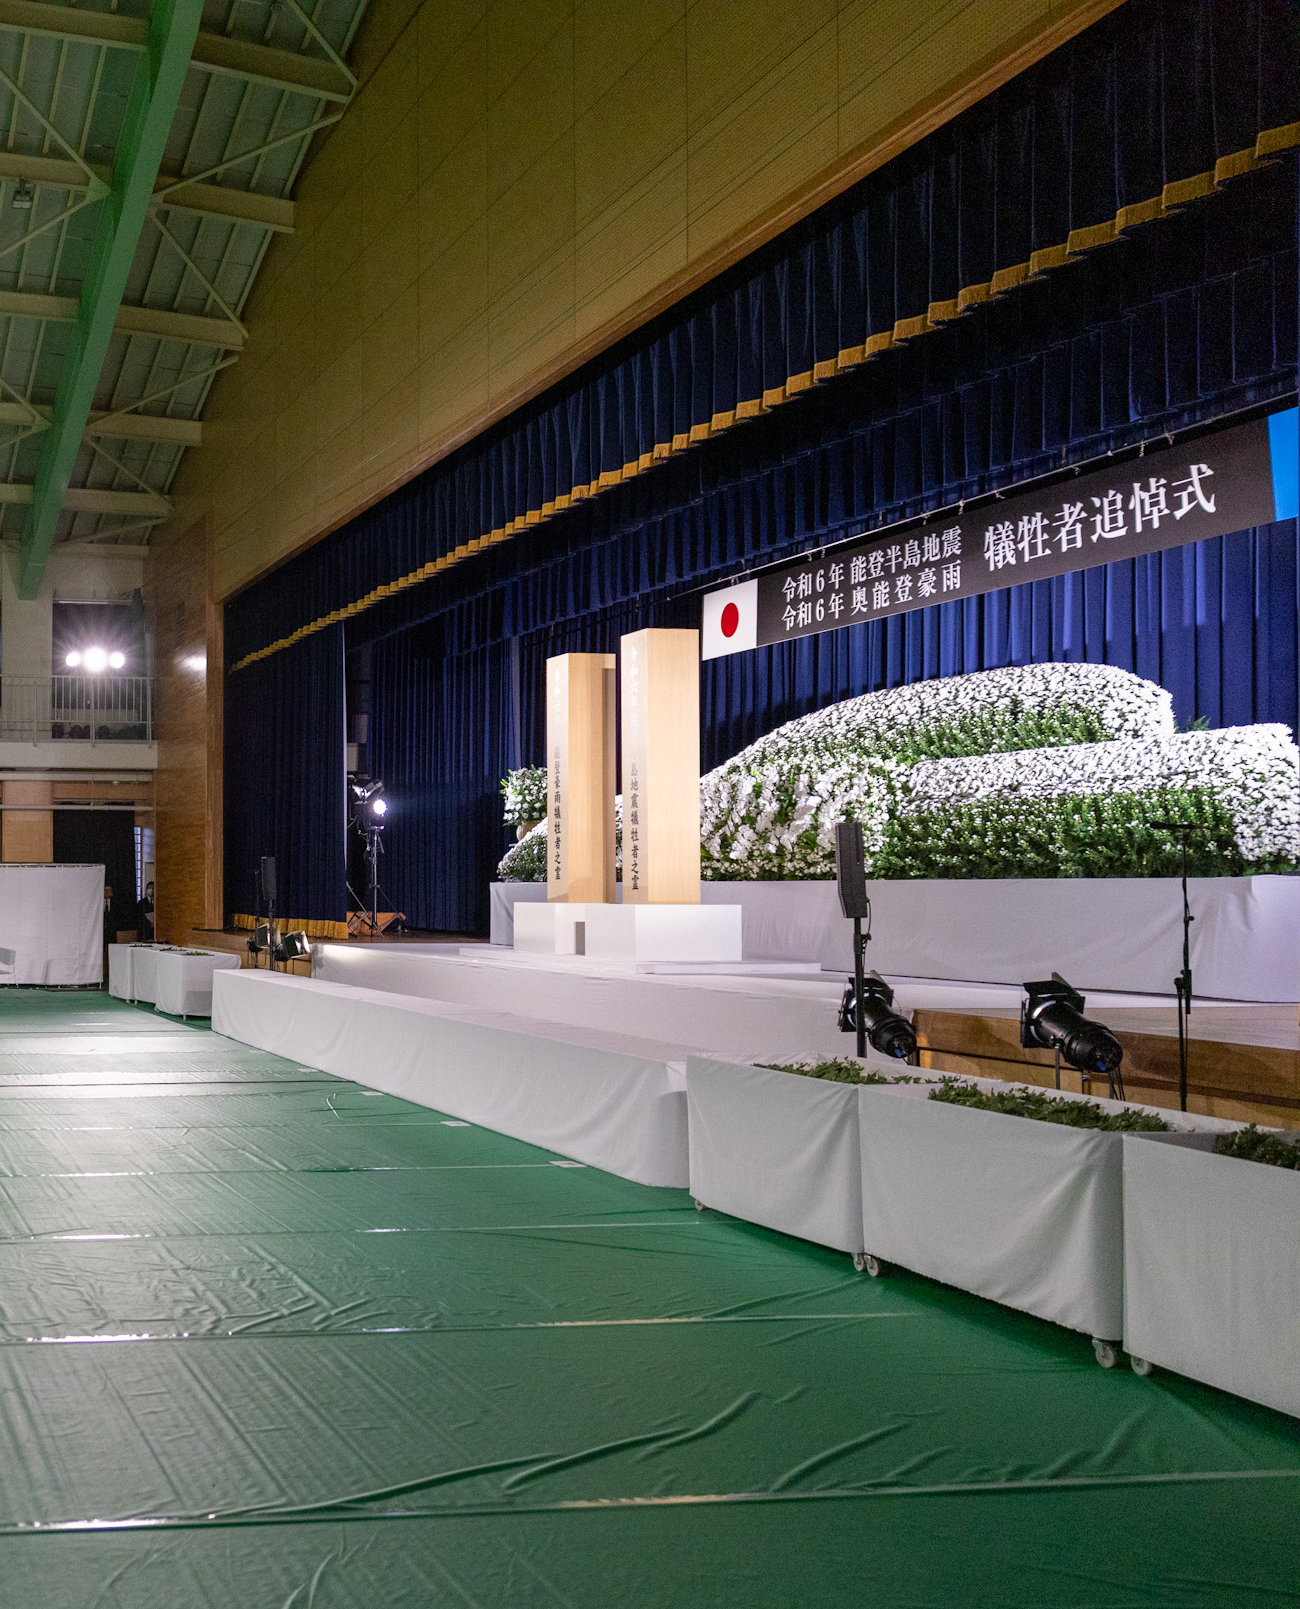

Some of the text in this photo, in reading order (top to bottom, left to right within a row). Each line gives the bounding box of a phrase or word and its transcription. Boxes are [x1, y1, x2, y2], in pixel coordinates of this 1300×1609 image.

[983, 463, 1217, 571] 犠牲者追悼式
[781, 560, 962, 631] 令和6年 奥能登豪雨
[782, 525, 962, 602] 令和6年 能登半島地震
